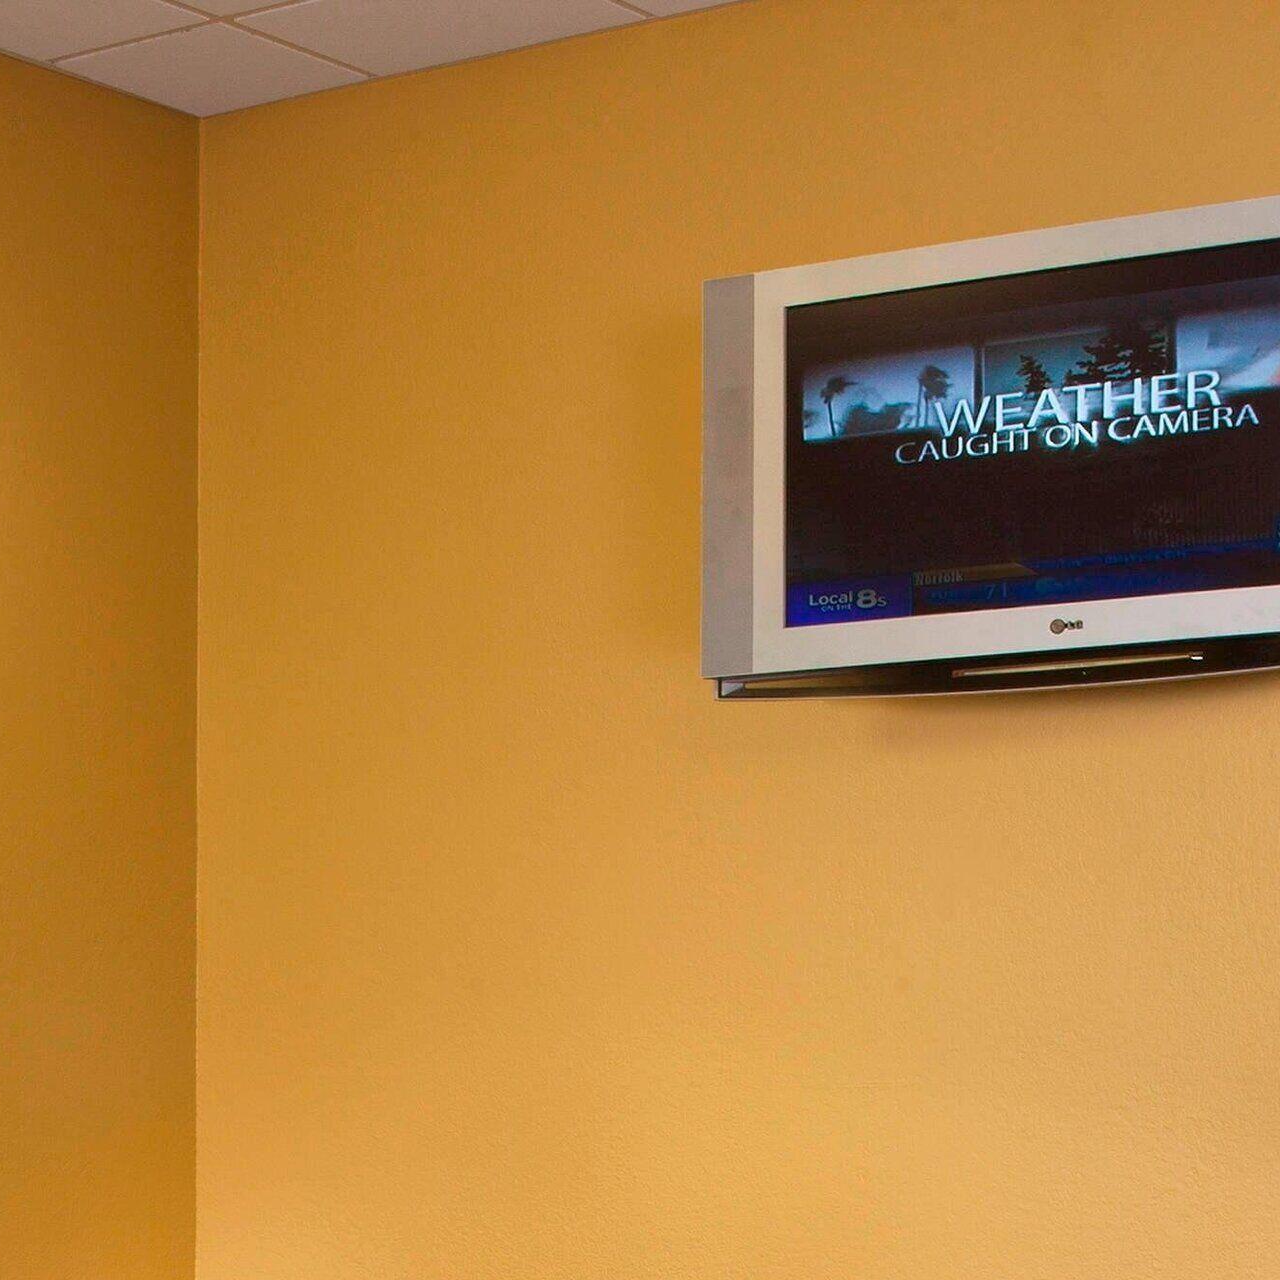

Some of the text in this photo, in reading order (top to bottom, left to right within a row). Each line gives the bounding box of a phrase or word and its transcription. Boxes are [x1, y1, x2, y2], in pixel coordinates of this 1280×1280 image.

[894, 403, 1260, 464] CAUGHT ON CAMERA
[934, 369, 1221, 437] WEATHER
[809, 590, 853, 606] Local
